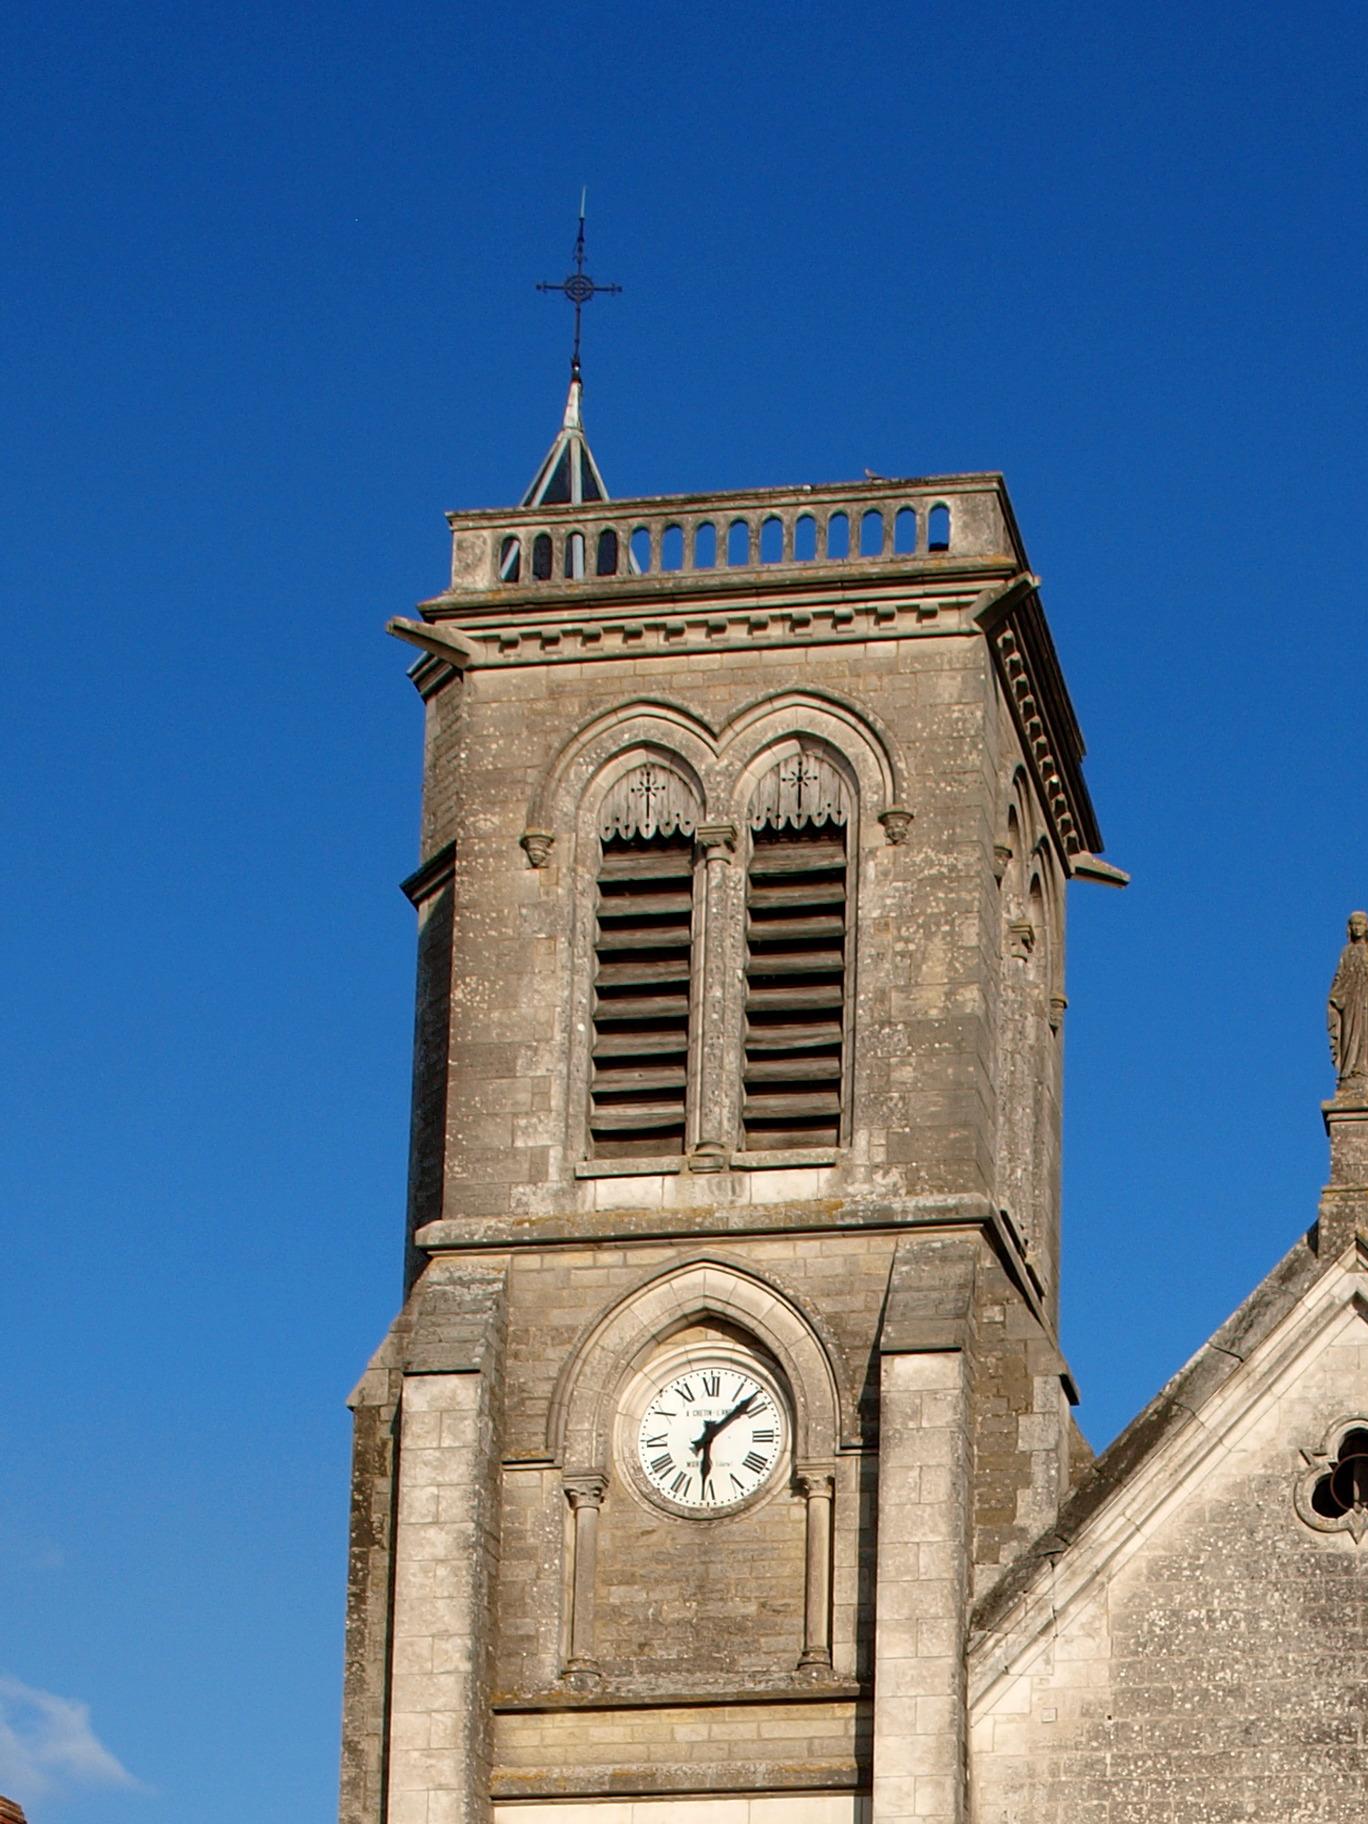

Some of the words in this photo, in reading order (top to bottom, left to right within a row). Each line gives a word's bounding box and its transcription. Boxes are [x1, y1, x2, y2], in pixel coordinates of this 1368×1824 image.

[702, 1376, 720, 1397] XII
[731, 1383, 745, 1402] I
[746, 1401, 768, 1419] II
[646, 1432, 668, 1448] IX
[751, 1429, 774, 1443] III
